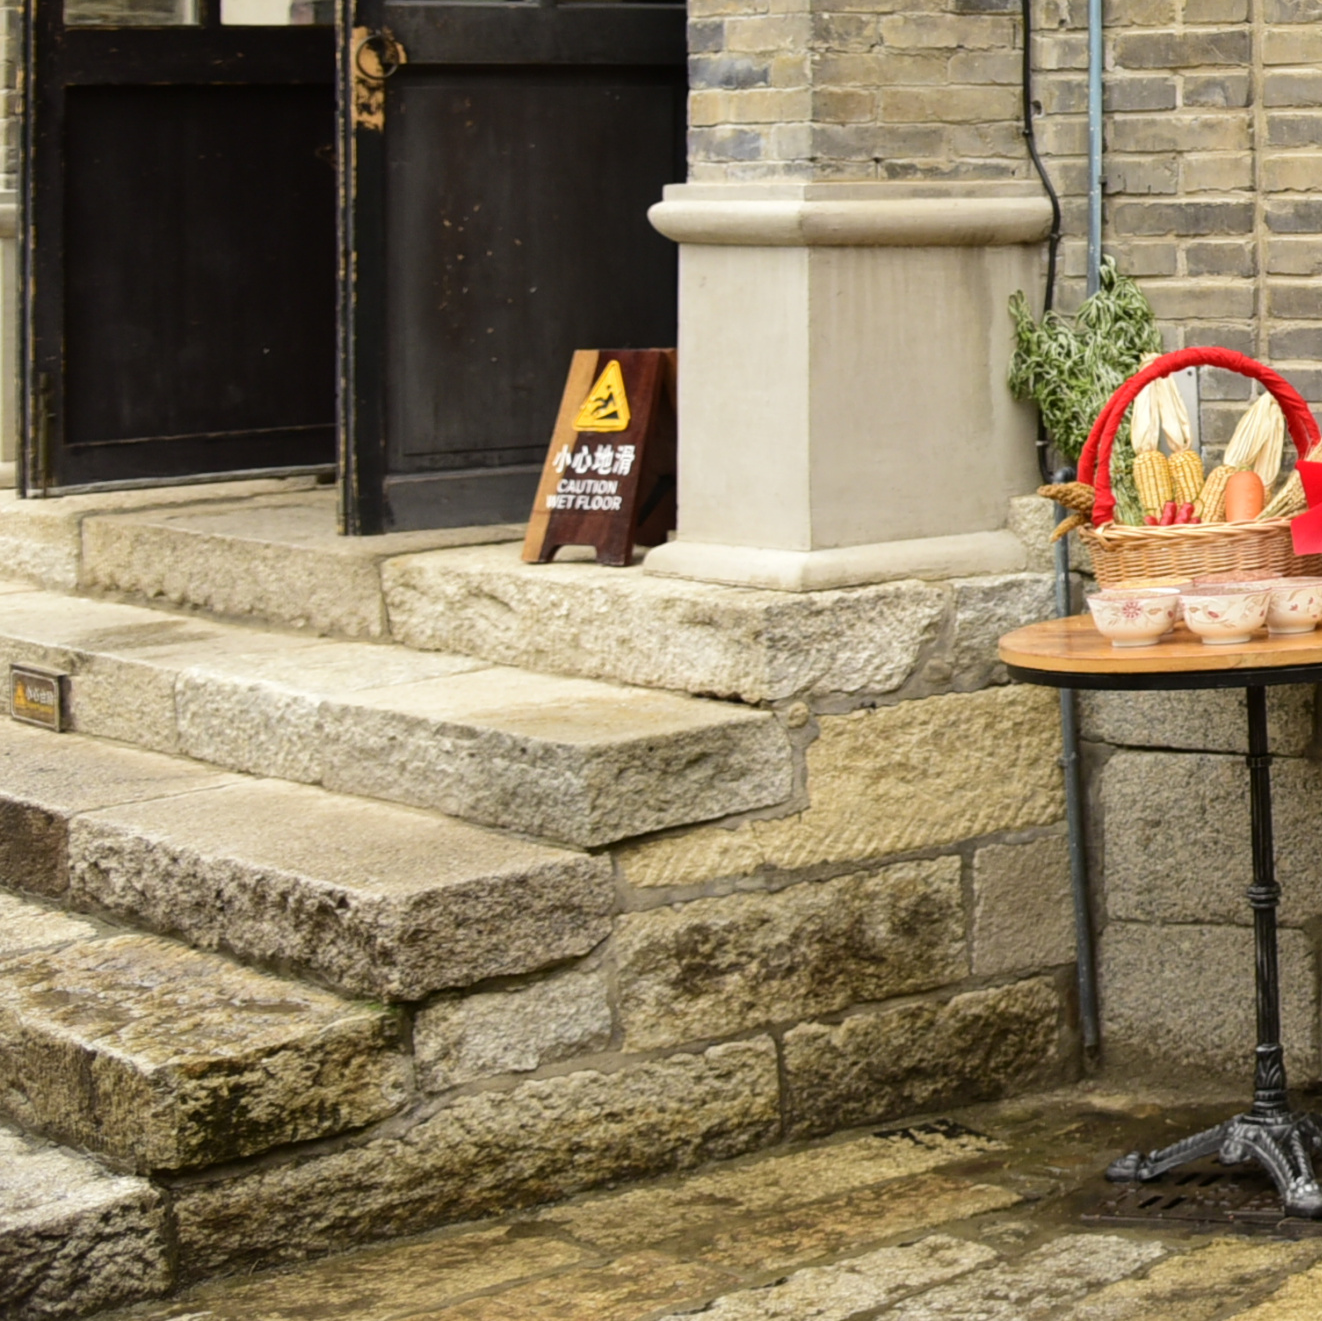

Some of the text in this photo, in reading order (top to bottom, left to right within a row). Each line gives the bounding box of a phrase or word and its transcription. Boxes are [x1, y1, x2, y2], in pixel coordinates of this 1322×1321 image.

[552, 444, 636, 476] 小心地滑
[556, 478, 619, 495] CAUTION
[546, 494, 623, 511] WET FLOOR
